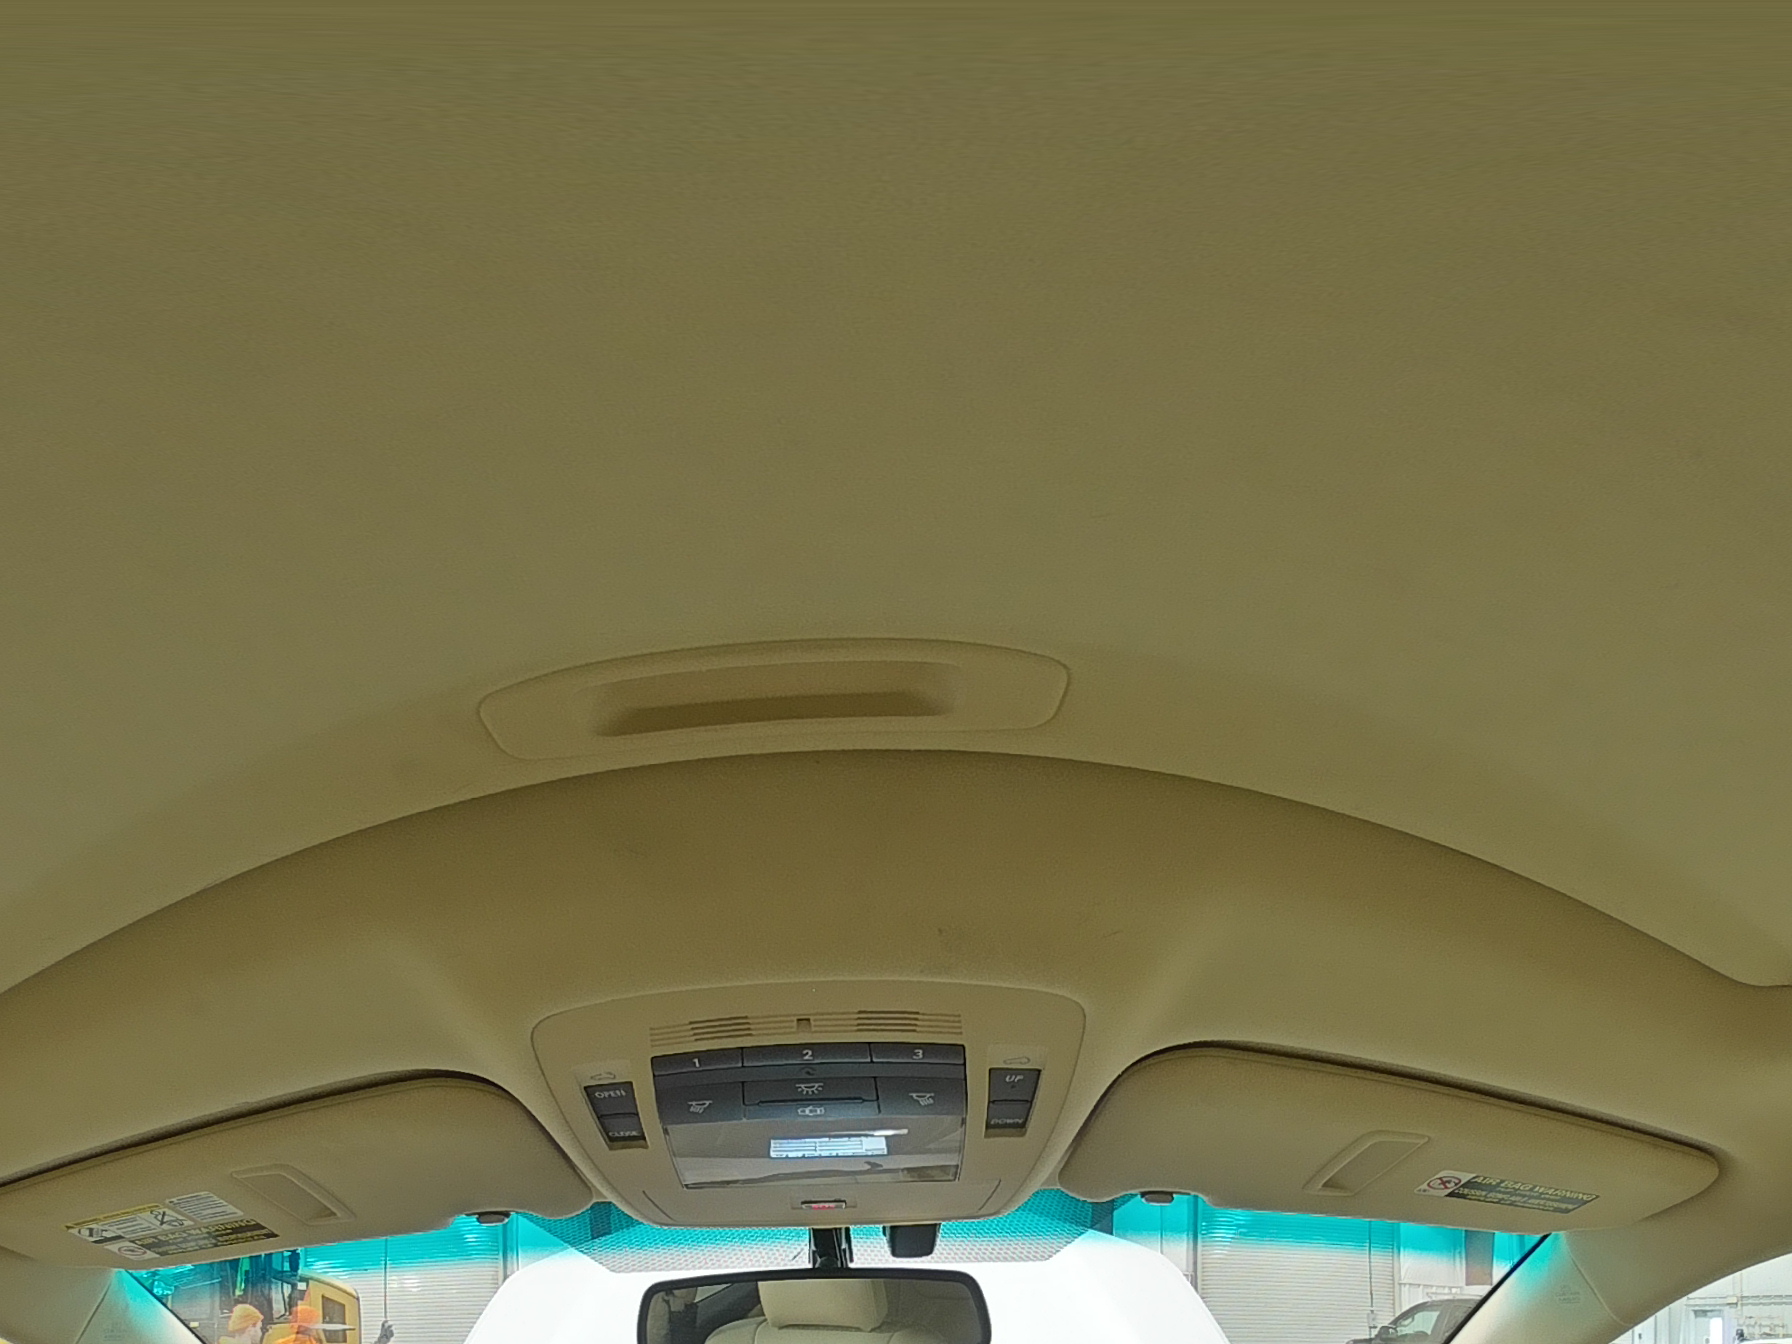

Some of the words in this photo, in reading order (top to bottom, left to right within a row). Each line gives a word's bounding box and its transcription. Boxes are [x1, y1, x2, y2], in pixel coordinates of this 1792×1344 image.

[802, 1049, 814, 1060] 2
[912, 1049, 924, 1060] 3
[692, 1058, 701, 1068] 1
[1005, 1074, 1025, 1083] UP
[594, 1088, 627, 1099] OPEN
[990, 1117, 1024, 1126] DOWN
[1500, 1180, 1533, 1191] BAG
[1533, 1185, 1598, 1201] WARNING
[188, 1219, 257, 1236] WARNING
